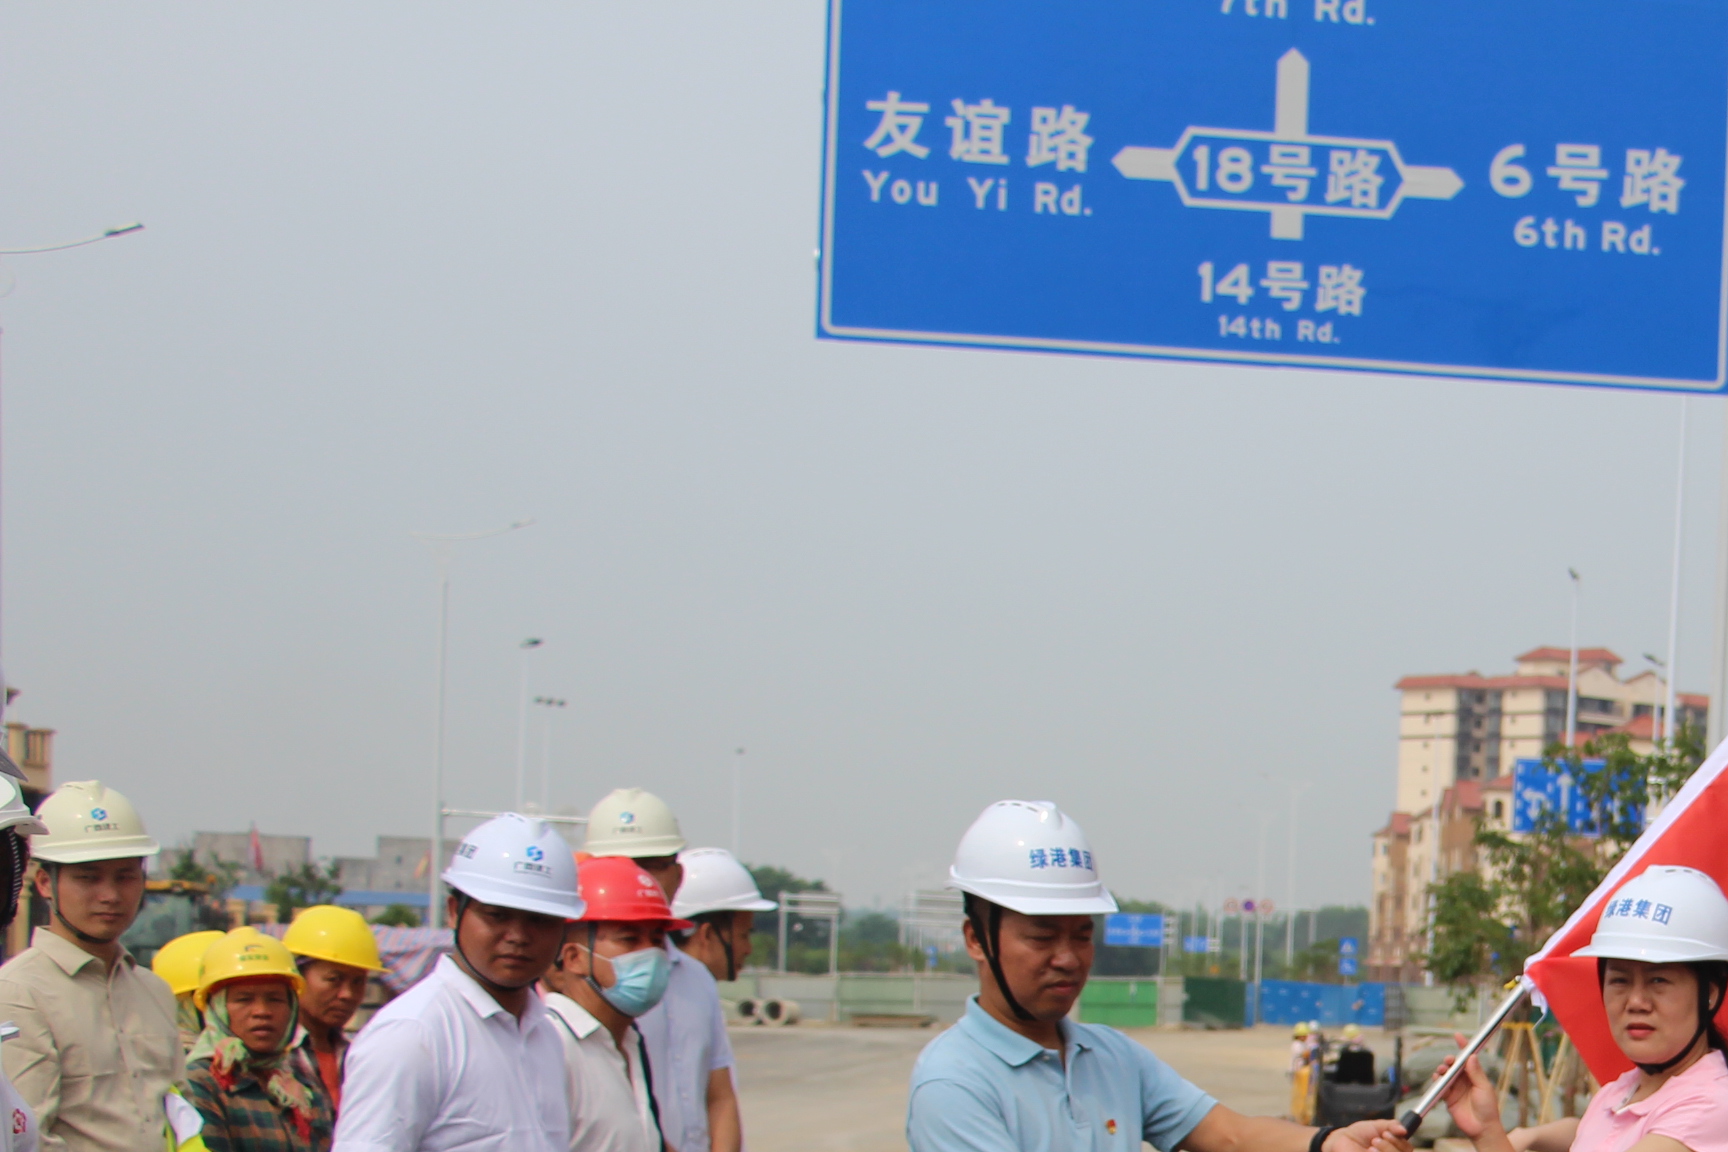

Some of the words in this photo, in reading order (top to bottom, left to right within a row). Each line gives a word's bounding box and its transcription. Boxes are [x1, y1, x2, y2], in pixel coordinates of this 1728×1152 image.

[1314, 0, 1376, 26] Rd.
[863, 91, 1095, 173] 友谊路
[862, 169, 939, 207] You
[966, 176, 1009, 211] Yi
[1034, 181, 1094, 217] Rd.
[1193, 144, 1385, 209] 18号路
[1489, 143, 1687, 214] 6号路
[1513, 215, 1587, 251] 6th
[1602, 220, 1662, 256] Rd.
[1198, 261, 1367, 316] 14号路
[1218, 314, 1283, 341] 14th
[1297, 318, 1341, 345] Rd.
